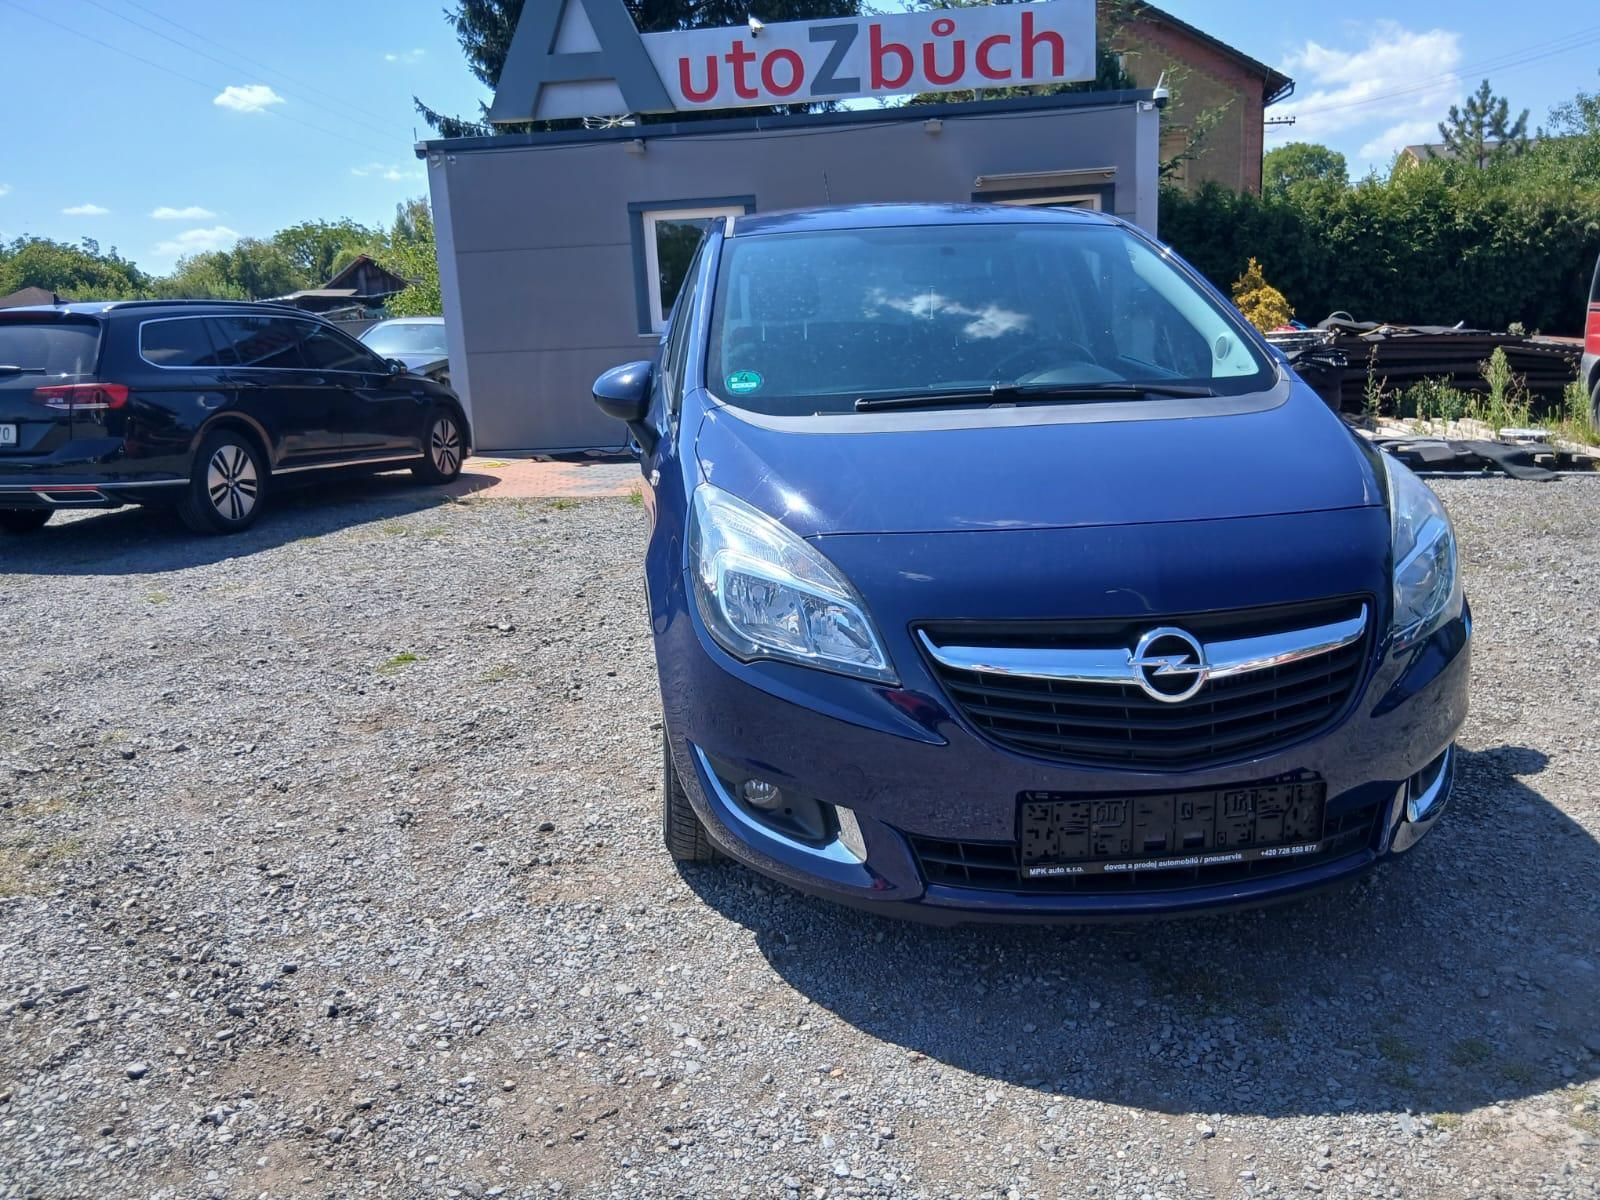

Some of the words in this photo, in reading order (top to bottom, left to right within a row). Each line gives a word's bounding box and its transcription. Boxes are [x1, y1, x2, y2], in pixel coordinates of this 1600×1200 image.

[490, 0, 1066, 122] AutoZbůch
[1029, 867, 1047, 876] MPK
[1048, 866, 1065, 874] auto
[1104, 863, 1126, 871] dovoz
[1134, 861, 1157, 870] prodej
[1158, 856, 1199, 867] automobilů
[1203, 853, 1242, 863] pneuservis
